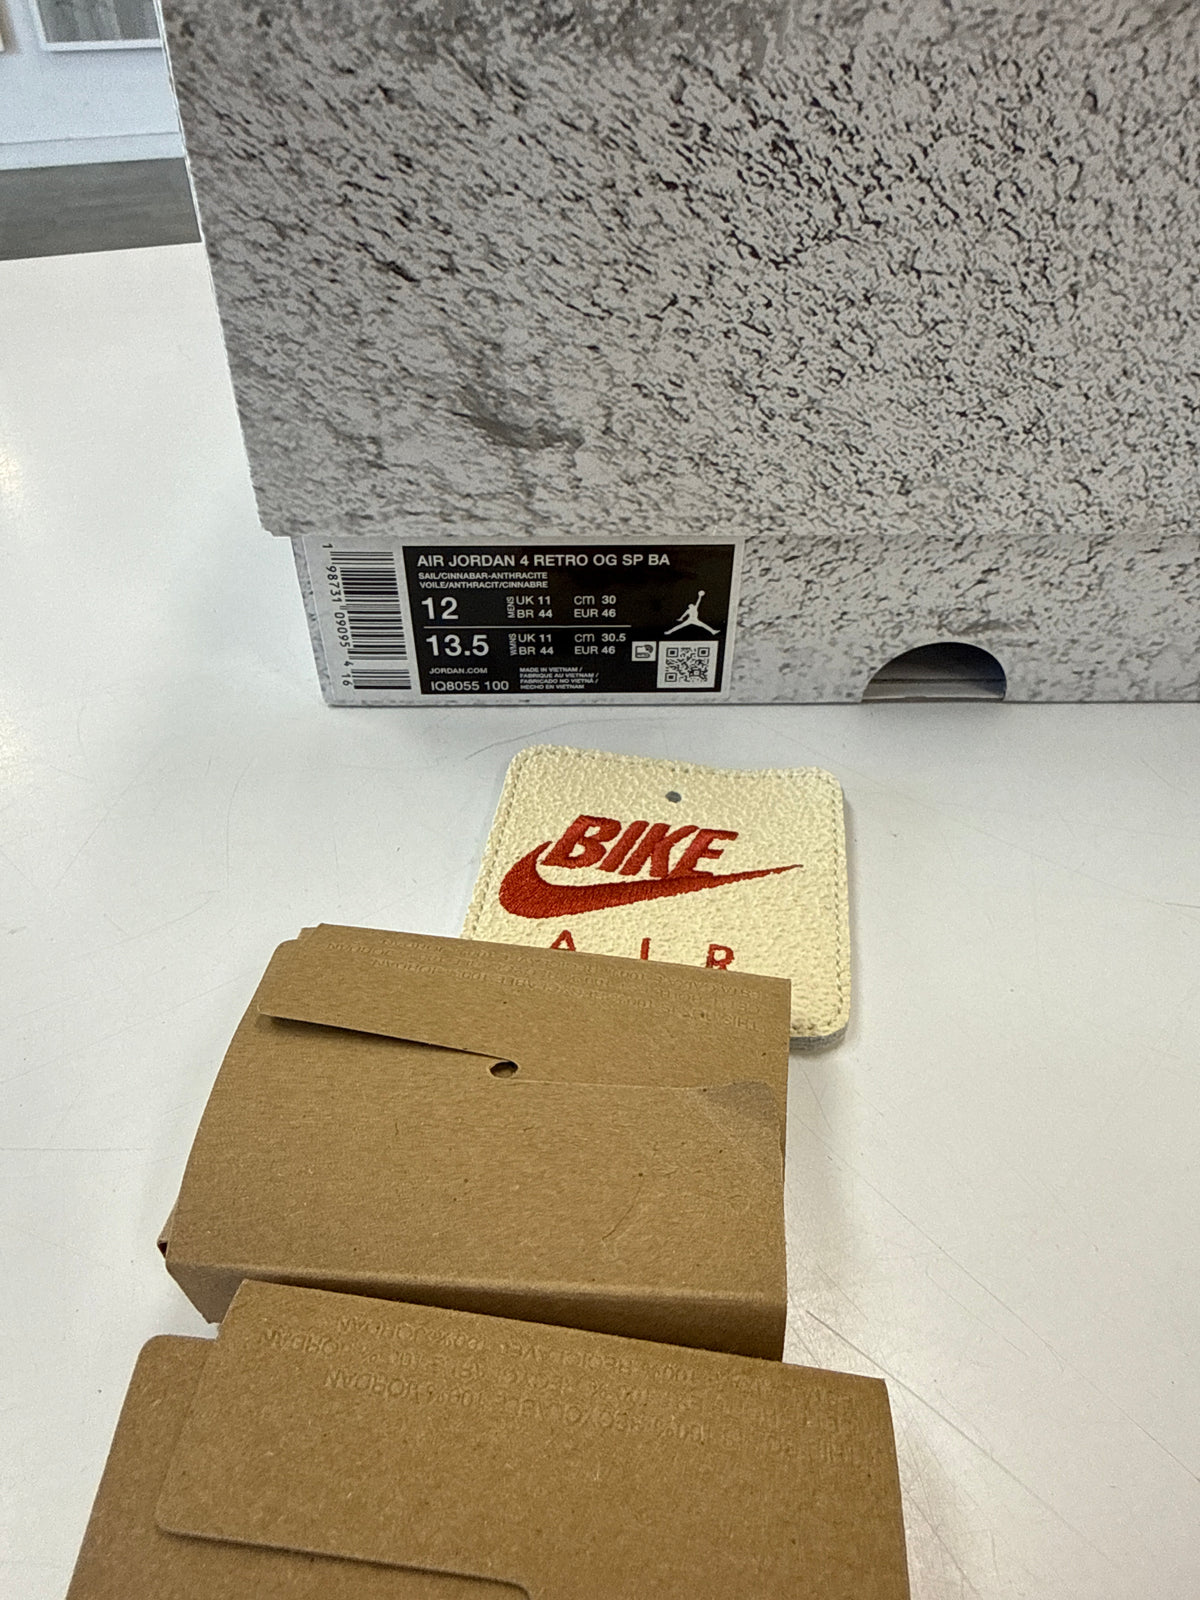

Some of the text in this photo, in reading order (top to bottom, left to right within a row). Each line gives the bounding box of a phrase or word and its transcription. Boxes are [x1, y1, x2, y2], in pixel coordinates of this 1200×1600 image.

[417, 554, 670, 567] AIR JORDAN 4 RETRO OG SP BA
[418, 571, 548, 580] SAIL/CINNABAR-ANTHRACITE
[326, 565, 342, 602] 98731
[419, 581, 548, 589] VOILE/ANTHRACIT/CINNABRE
[516, 595, 616, 605] UK 11 cm 30
[421, 596, 459, 620] 12
[506, 596, 516, 618] MENS
[517, 608, 616, 619] BR 44 EUR 46
[334, 612, 350, 648] 09095
[518, 633, 626, 643] UK 11 cm 30.5
[426, 634, 490, 656] 13.5
[518, 645, 616, 655] BR 44 EUR 46
[429, 667, 488, 675] JORDAN.COM
[341, 673, 353, 686] 16
[430, 681, 509, 691] IQ8055 100
[541, 814, 739, 879] BIKE
[323, 1368, 420, 1401] JORDAN
